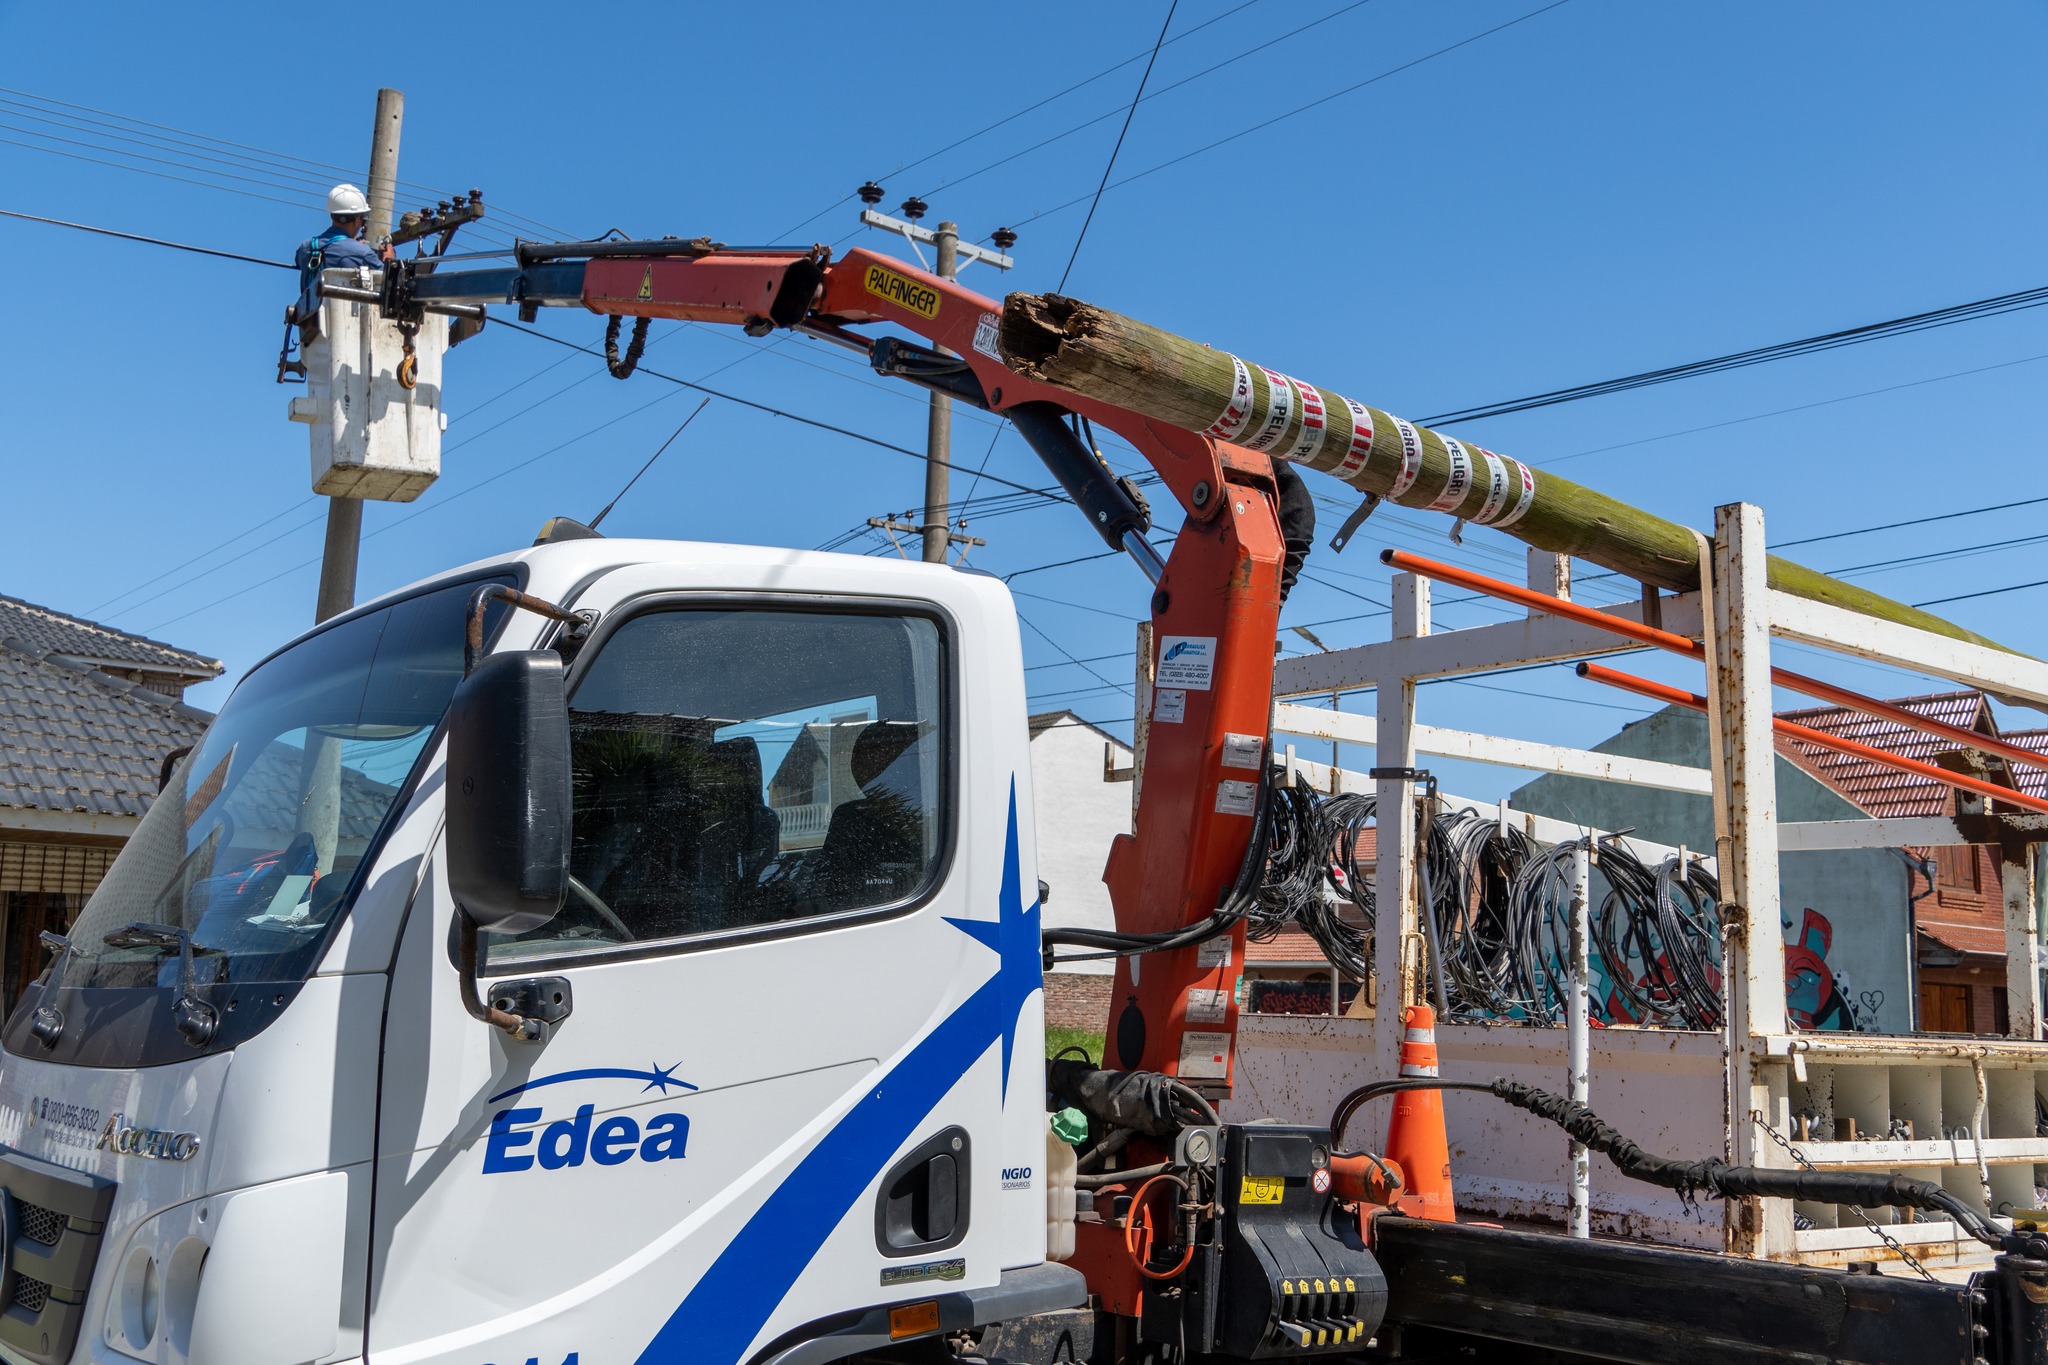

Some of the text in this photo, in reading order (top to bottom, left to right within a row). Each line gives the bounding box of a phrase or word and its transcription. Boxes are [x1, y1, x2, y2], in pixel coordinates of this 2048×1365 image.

[868, 268, 936, 314] PALFINGER
[1446, 441, 1465, 496] PELIGRO
[482, 1103, 690, 1175] Edea
[1001, 1166, 1032, 1180] NGIO
